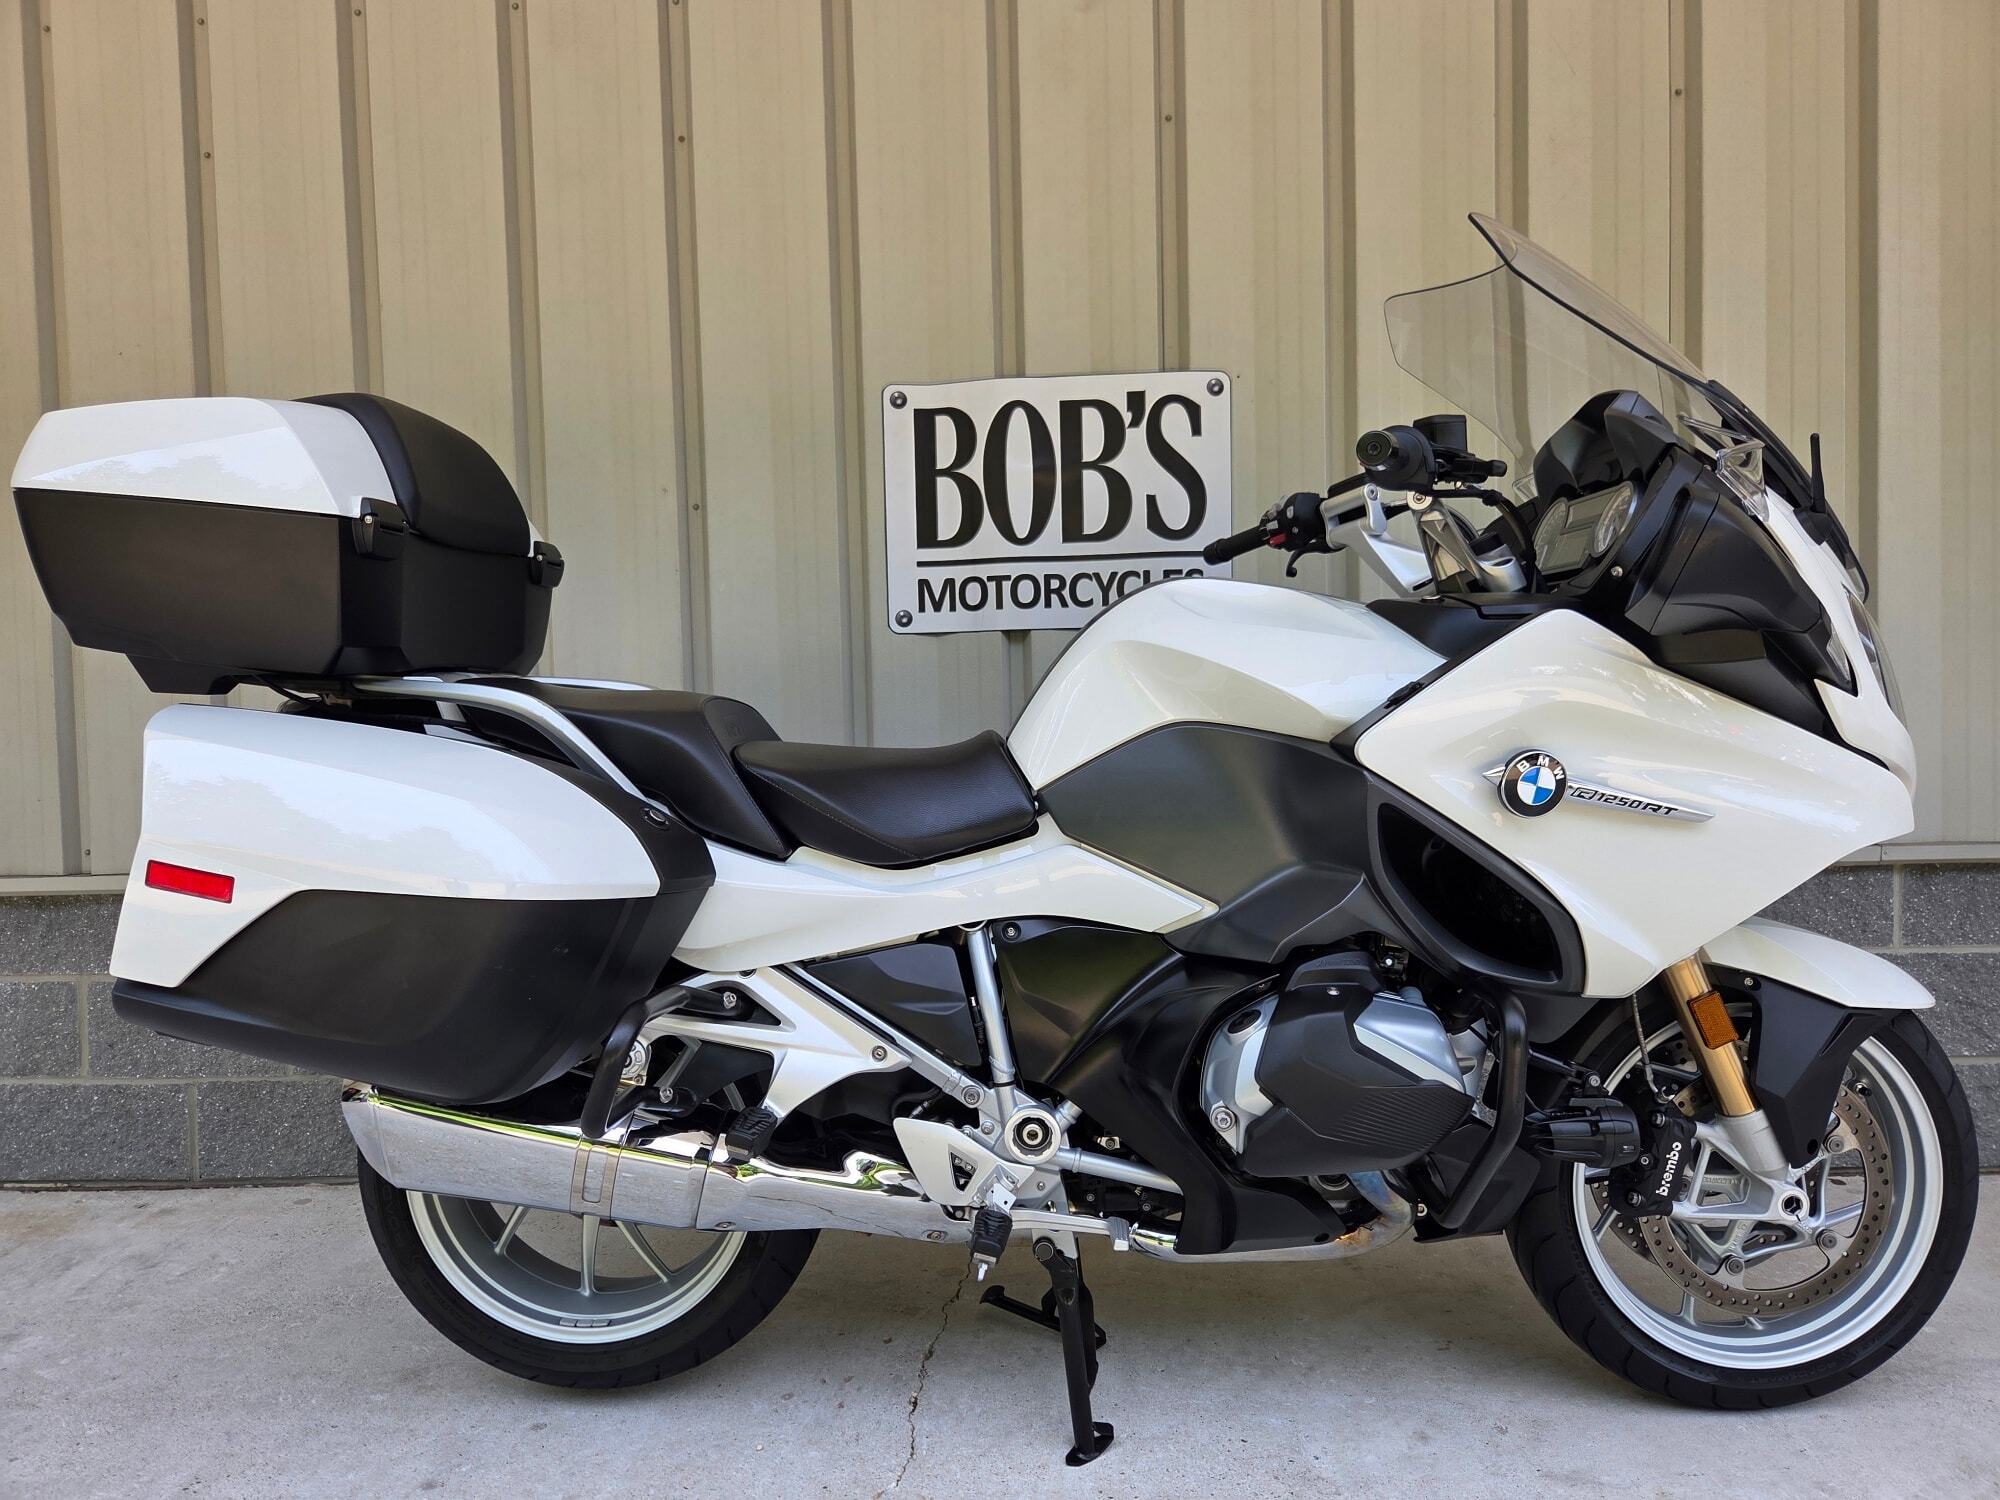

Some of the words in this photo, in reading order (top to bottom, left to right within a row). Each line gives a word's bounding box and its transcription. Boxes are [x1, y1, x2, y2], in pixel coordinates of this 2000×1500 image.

[913, 390, 1207, 549] BOB'S
[917, 568, 1204, 613] MOTORCYC
[1516, 755, 1565, 780] BMW
[1655, 1141, 1682, 1196] brembo
